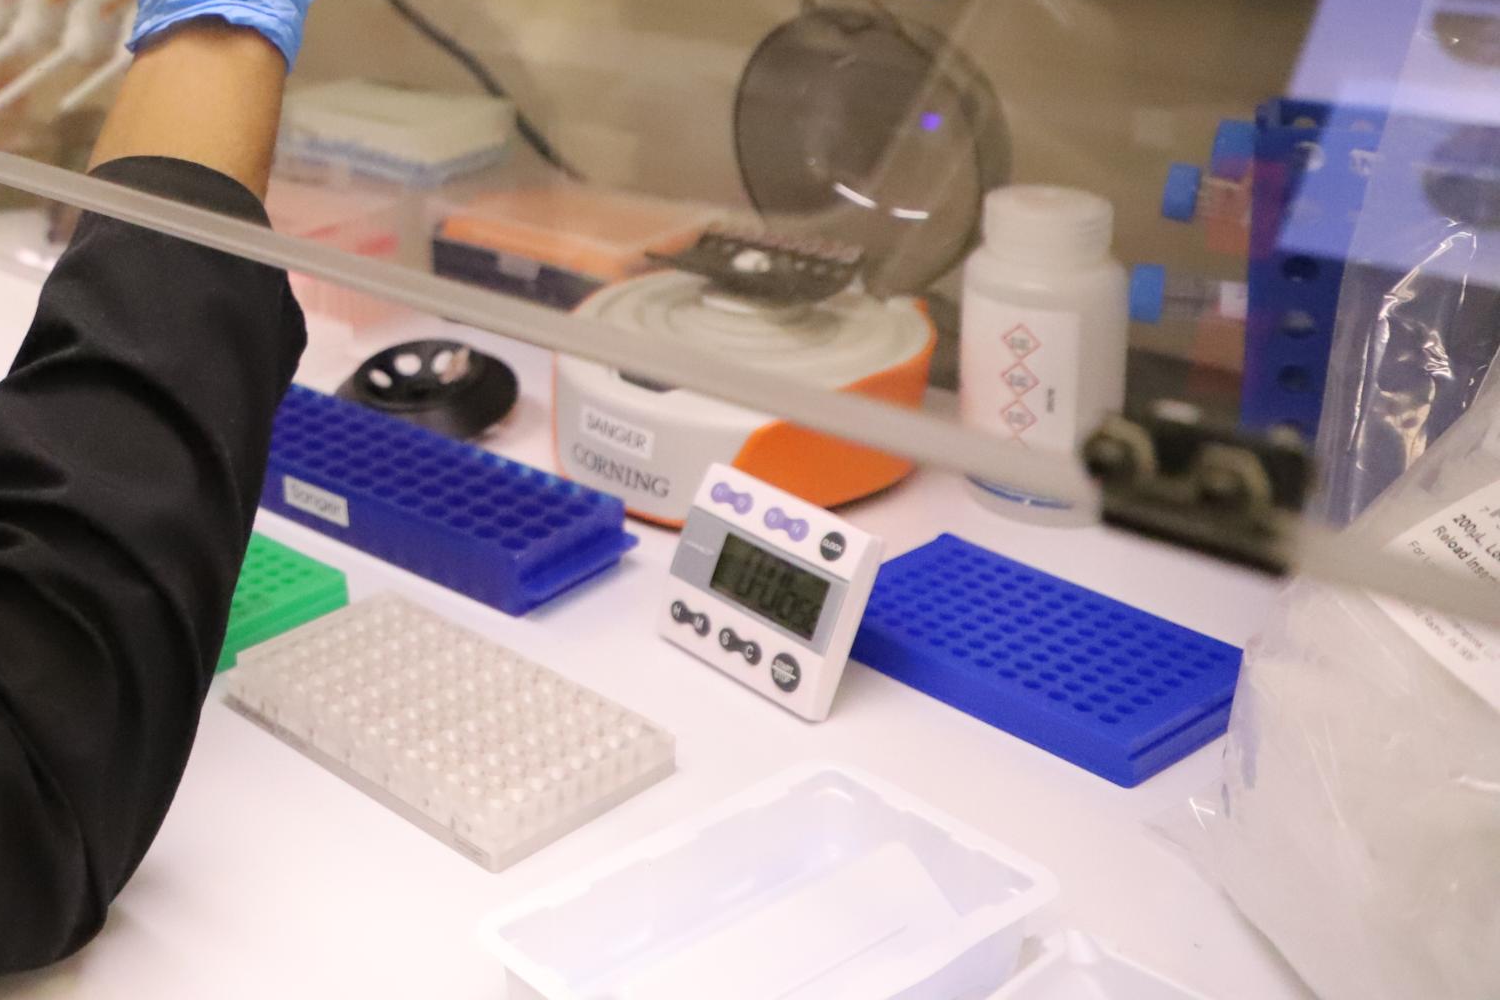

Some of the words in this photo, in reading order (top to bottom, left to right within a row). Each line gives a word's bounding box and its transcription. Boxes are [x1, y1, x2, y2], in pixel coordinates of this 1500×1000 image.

[586, 412, 648, 450] SANGER
[571, 441, 671, 499] CORNING
[1432, 524, 1470, 560] Reload
[721, 630, 731, 646] S
[745, 644, 755, 659] C
